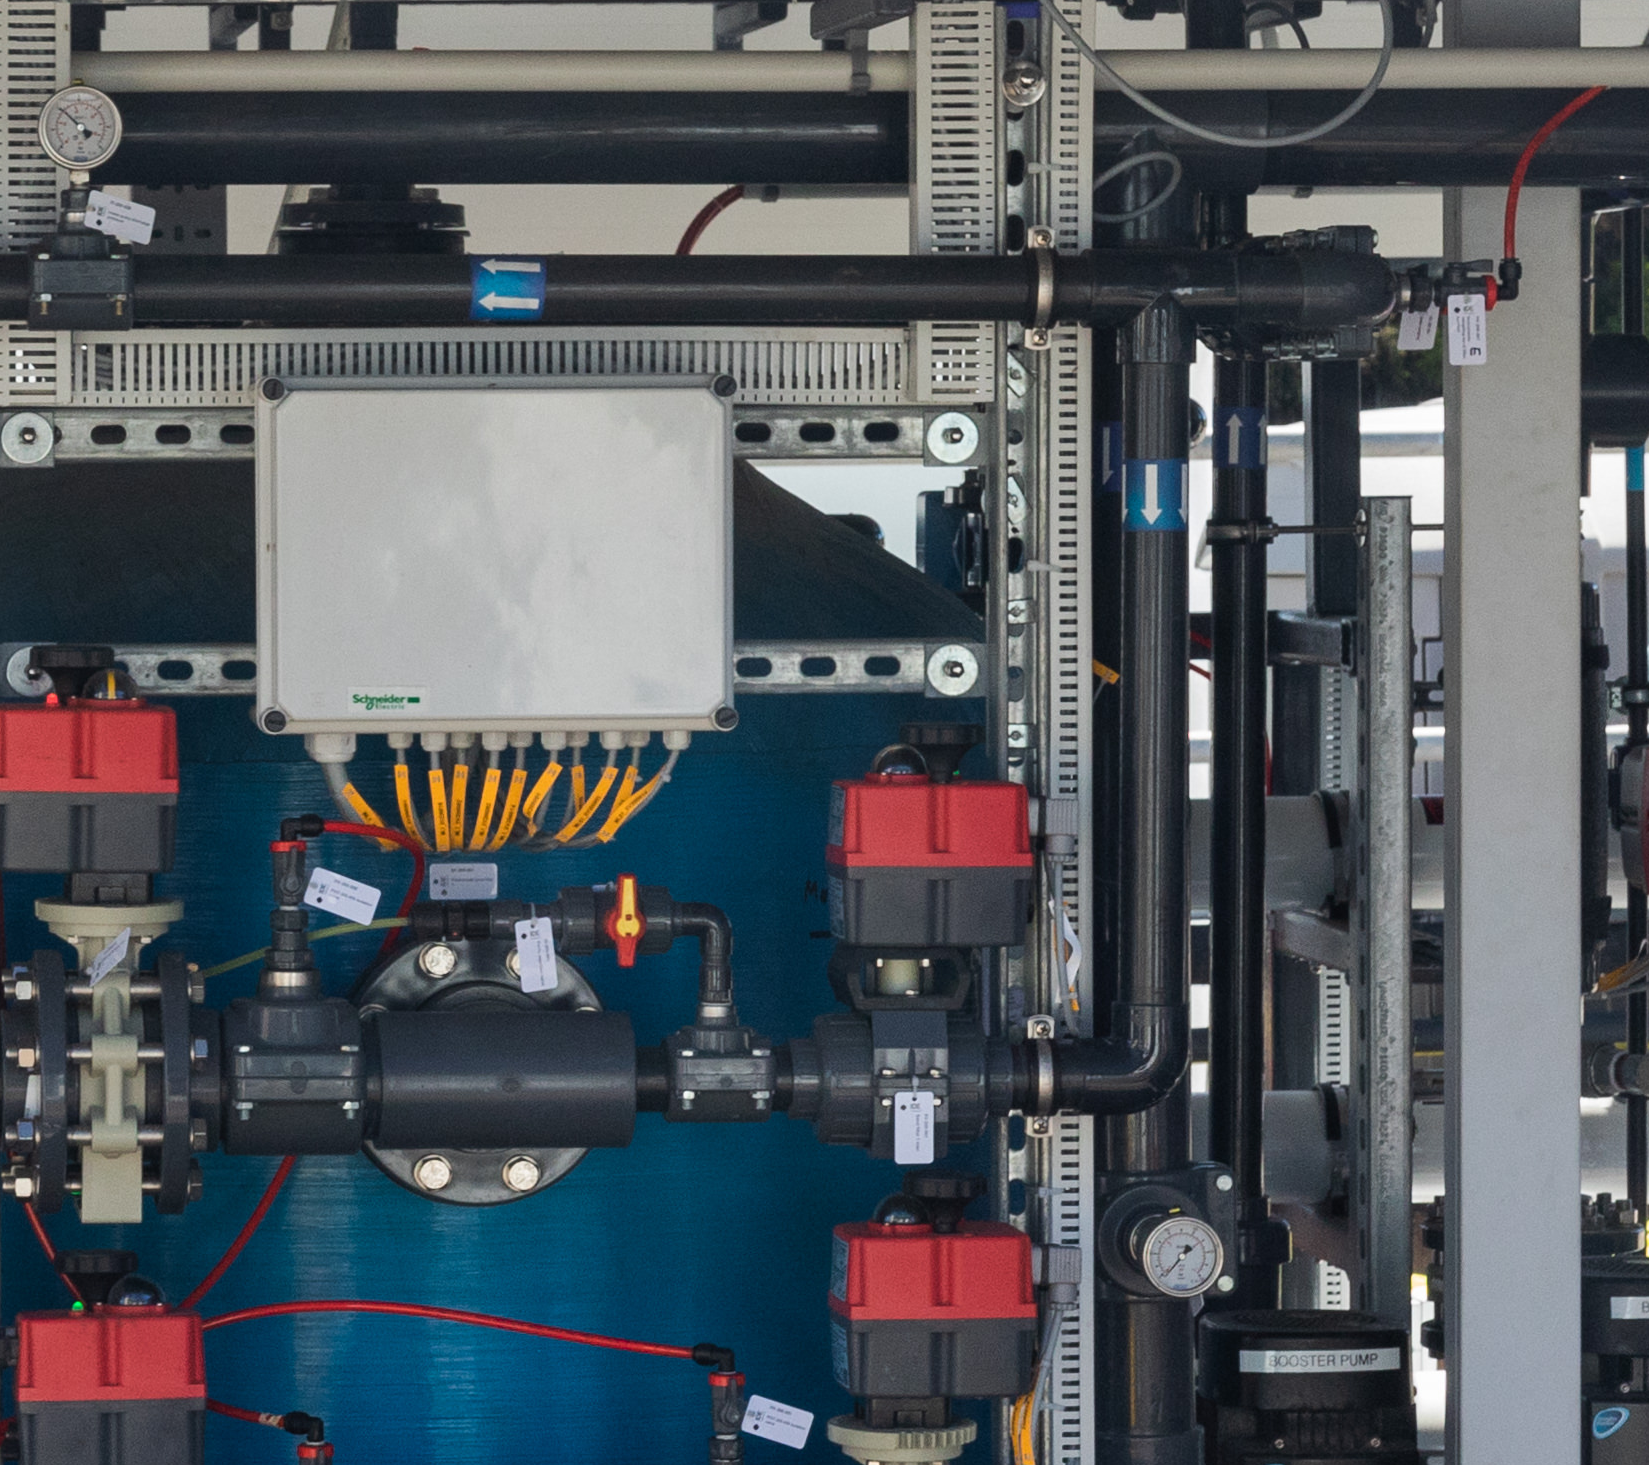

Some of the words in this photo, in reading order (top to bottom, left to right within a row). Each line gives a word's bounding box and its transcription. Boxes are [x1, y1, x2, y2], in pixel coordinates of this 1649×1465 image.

[352, 694, 406, 711] Schneider
[1269, 1353, 1336, 1368] BOOSTER
[1340, 1352, 1379, 1367] PUMP
